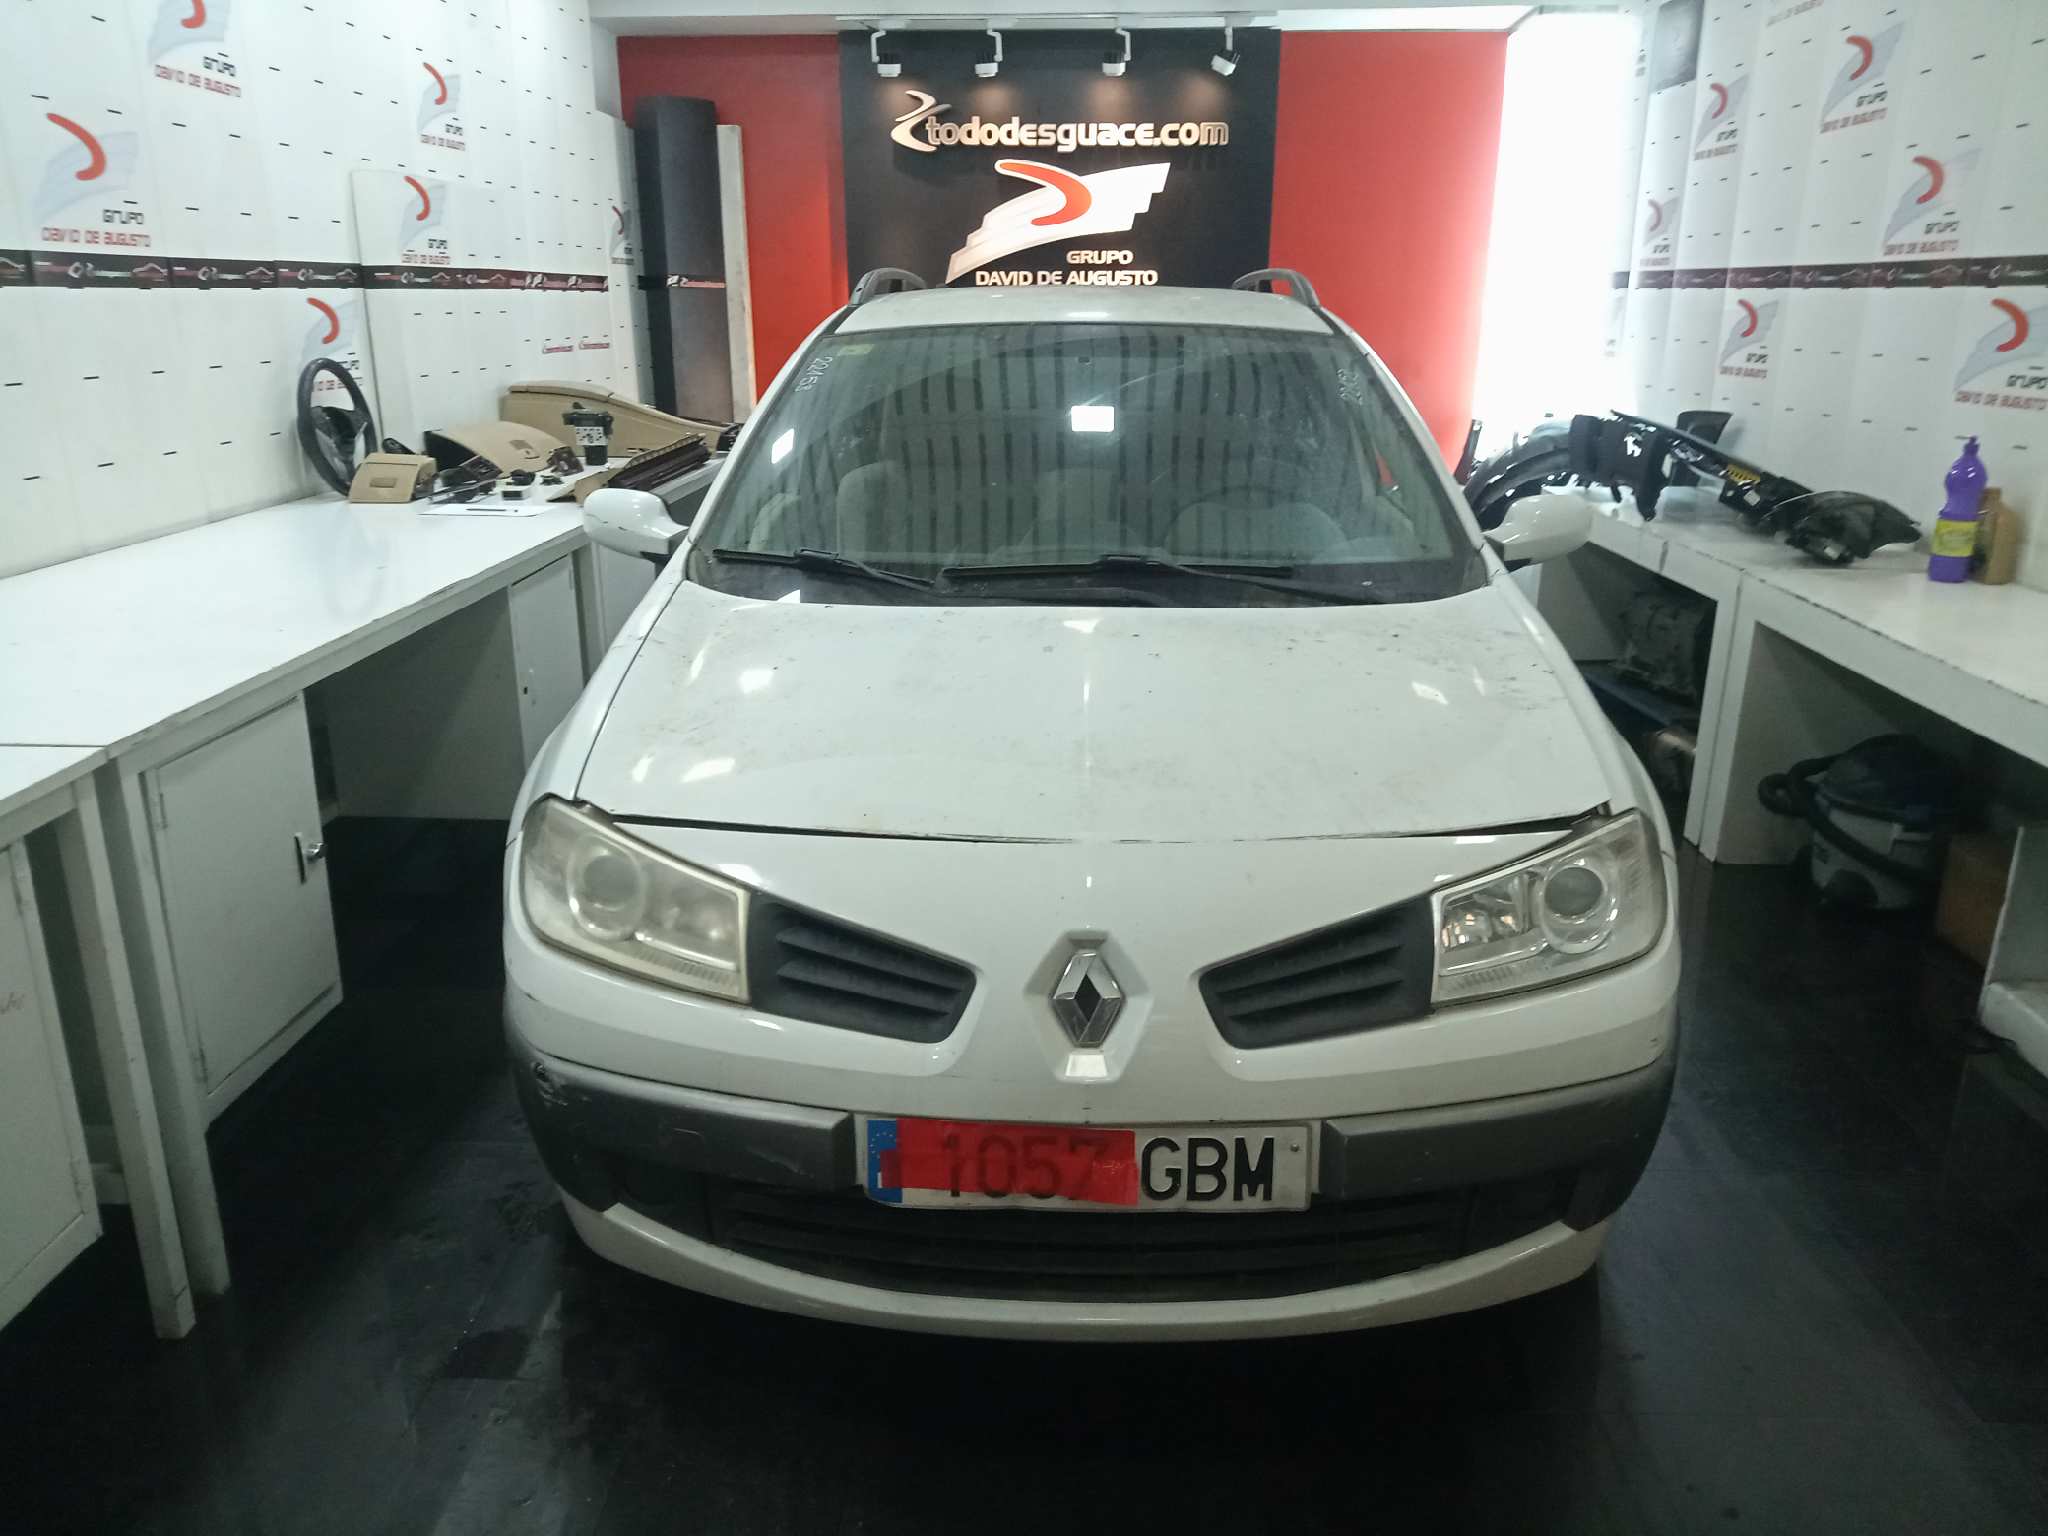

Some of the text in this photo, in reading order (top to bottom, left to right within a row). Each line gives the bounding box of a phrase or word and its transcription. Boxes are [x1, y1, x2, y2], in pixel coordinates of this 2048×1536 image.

[926, 115, 1229, 152] tododesguace.com
[1066, 249, 1133, 264] GRUPO
[976, 269, 1158, 285] DAVID DE AUGUSTO
[946, 1132, 1275, 1201] 1057 GBM
